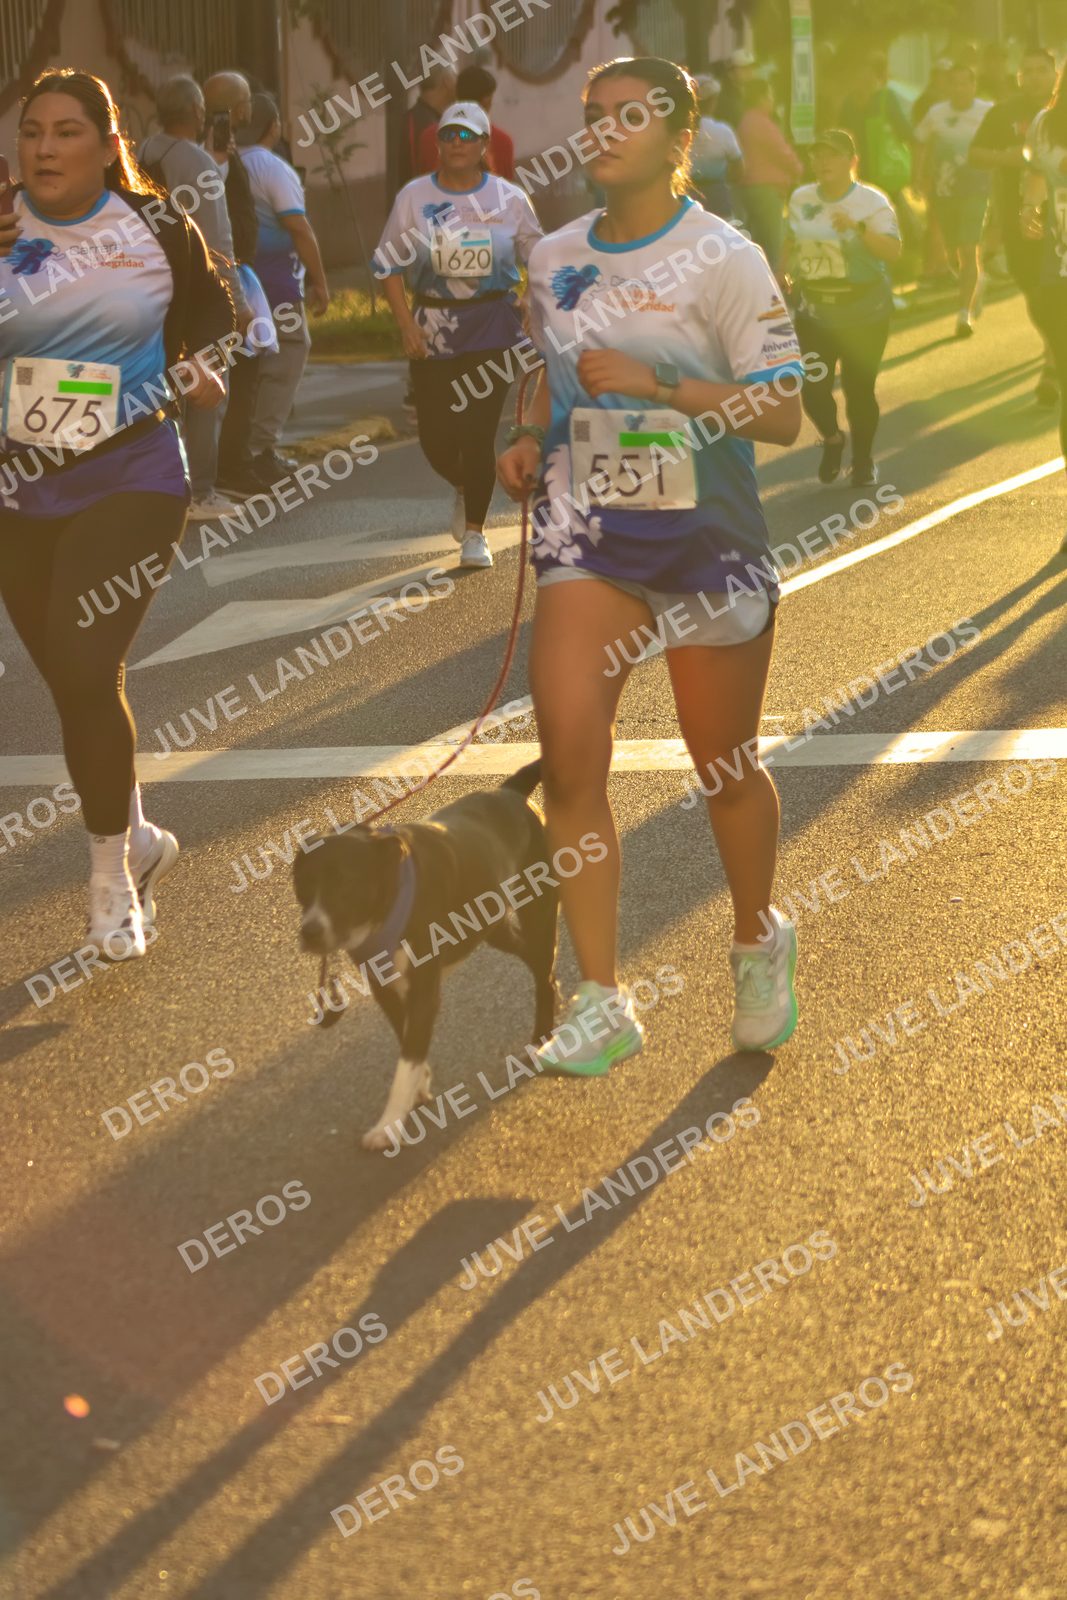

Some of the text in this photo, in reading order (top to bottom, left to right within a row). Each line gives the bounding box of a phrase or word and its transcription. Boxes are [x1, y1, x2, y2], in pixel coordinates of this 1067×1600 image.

[435, 248, 491, 271] 1620
[24, 396, 102, 437] 675
[588, 453, 664, 498] 551
